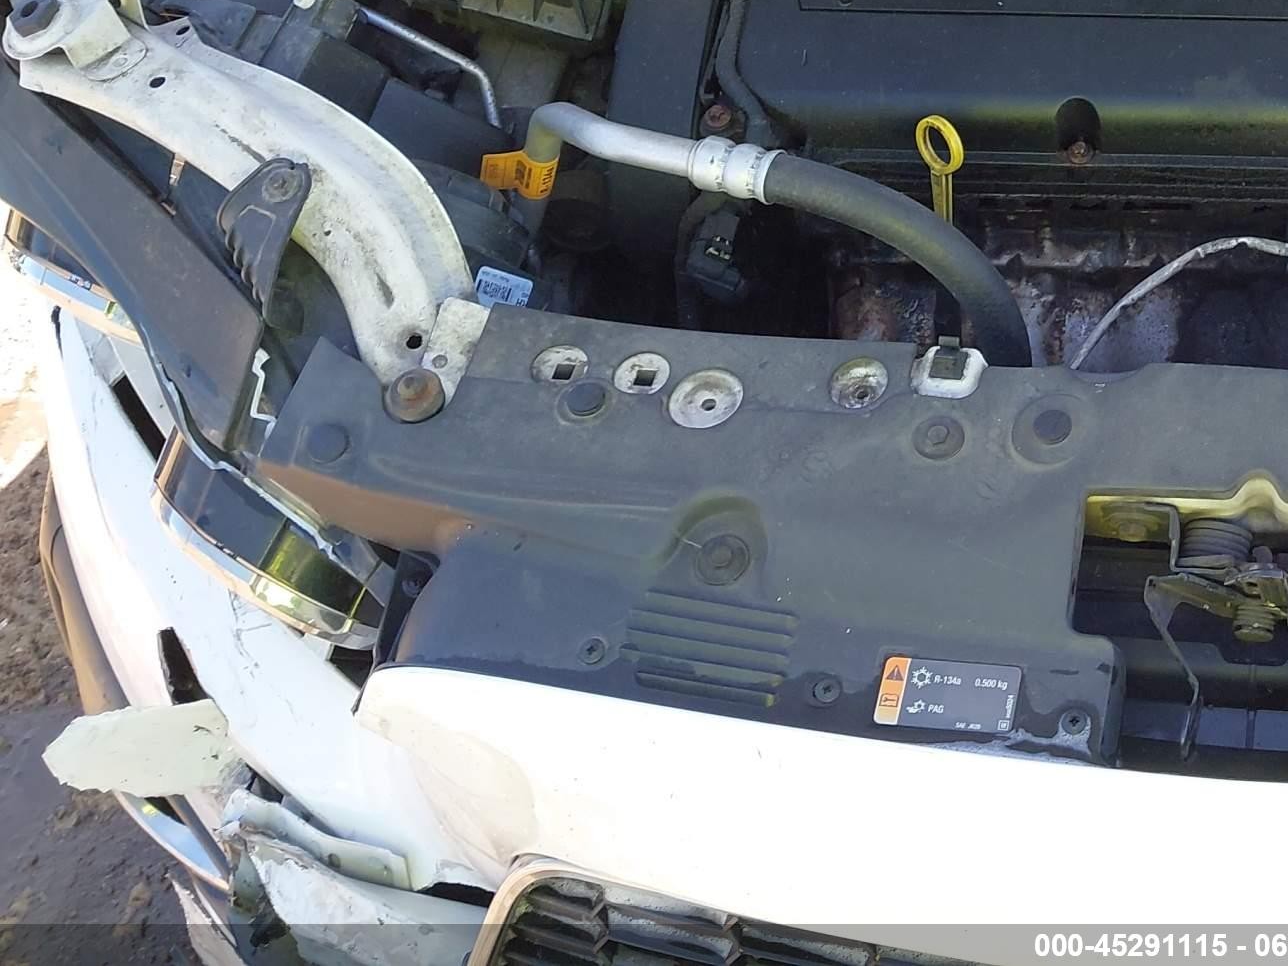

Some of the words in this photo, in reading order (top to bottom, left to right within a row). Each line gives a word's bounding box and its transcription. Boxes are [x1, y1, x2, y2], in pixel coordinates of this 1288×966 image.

[933, 675, 962, 686] R-134a
[974, 677, 997, 689] 0.500
[997, 679, 1009, 691] kg
[927, 703, 945, 714] PAG
